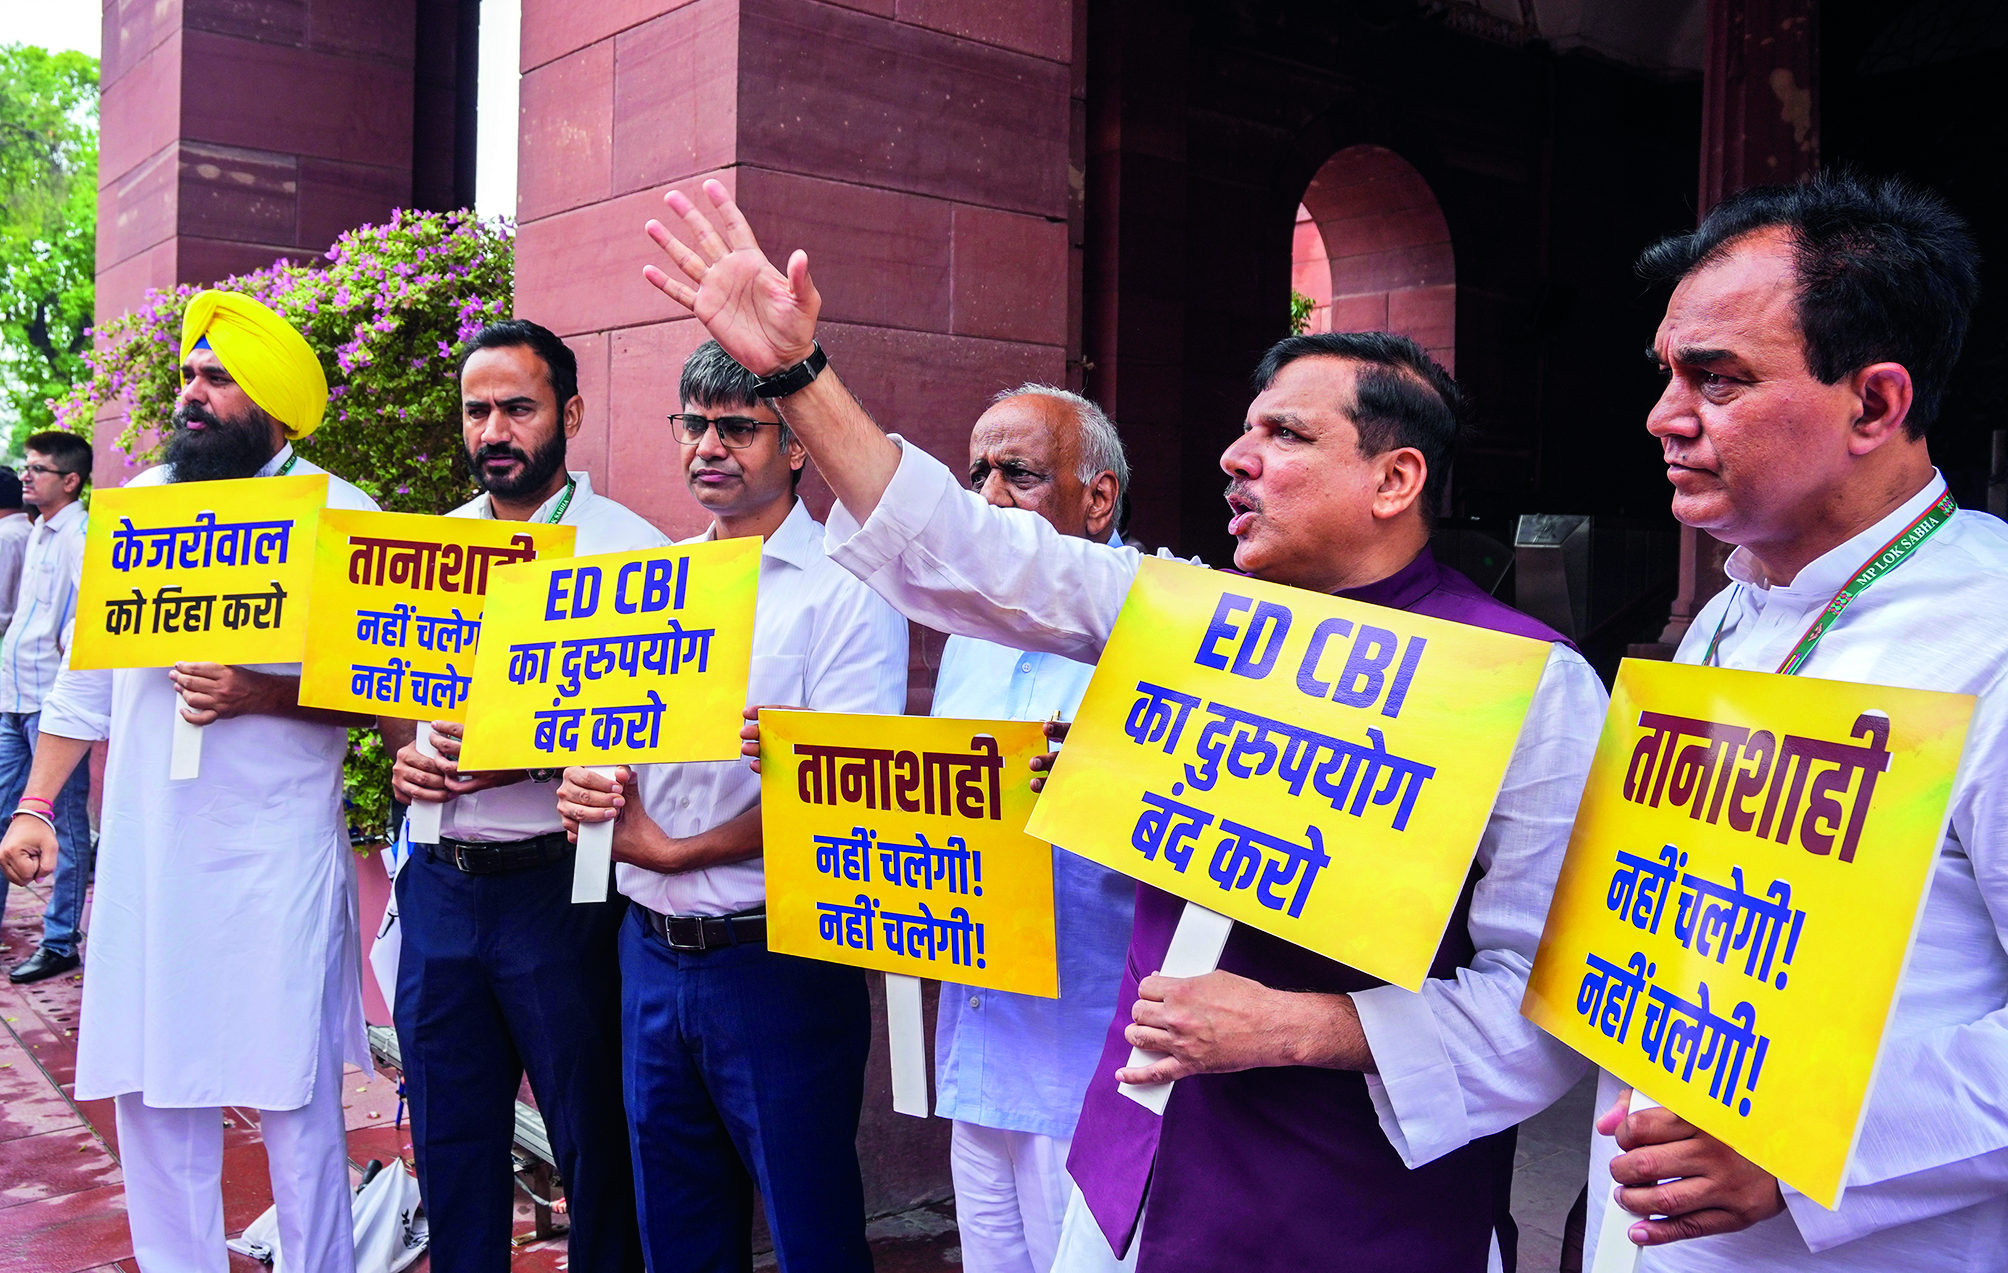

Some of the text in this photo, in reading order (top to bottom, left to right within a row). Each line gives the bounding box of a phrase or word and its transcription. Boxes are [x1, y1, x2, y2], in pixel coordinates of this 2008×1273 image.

[111, 510, 295, 573] केजरीवाल
[1856, 516, 1940, 586] MP LOK SABHA
[105, 580, 288, 636] को रिहा करो
[544, 556, 690, 622] ED CBI
[355, 602, 484, 656] नहीं चलेग
[507, 618, 716, 698] का दुरुपयोग
[1194, 592, 1427, 719] ED CBI
[350, 657, 473, 710] नहीं चलेग
[533, 690, 667, 753] बंद करो
[793, 734, 1004, 821] तानाशाही
[1124, 680, 1437, 832] का दुरुपयोग
[1622, 709, 1893, 864] तानाशाही
[813, 826, 983, 897] नहीं चलेगी!
[1131, 781, 1332, 920] बंद करो
[816, 893, 986, 970] नहीं चलेगी!
[1606, 843, 1807, 991] नहीं चलेगी!
[1576, 951, 1771, 1118] नहीं चलेगी!
